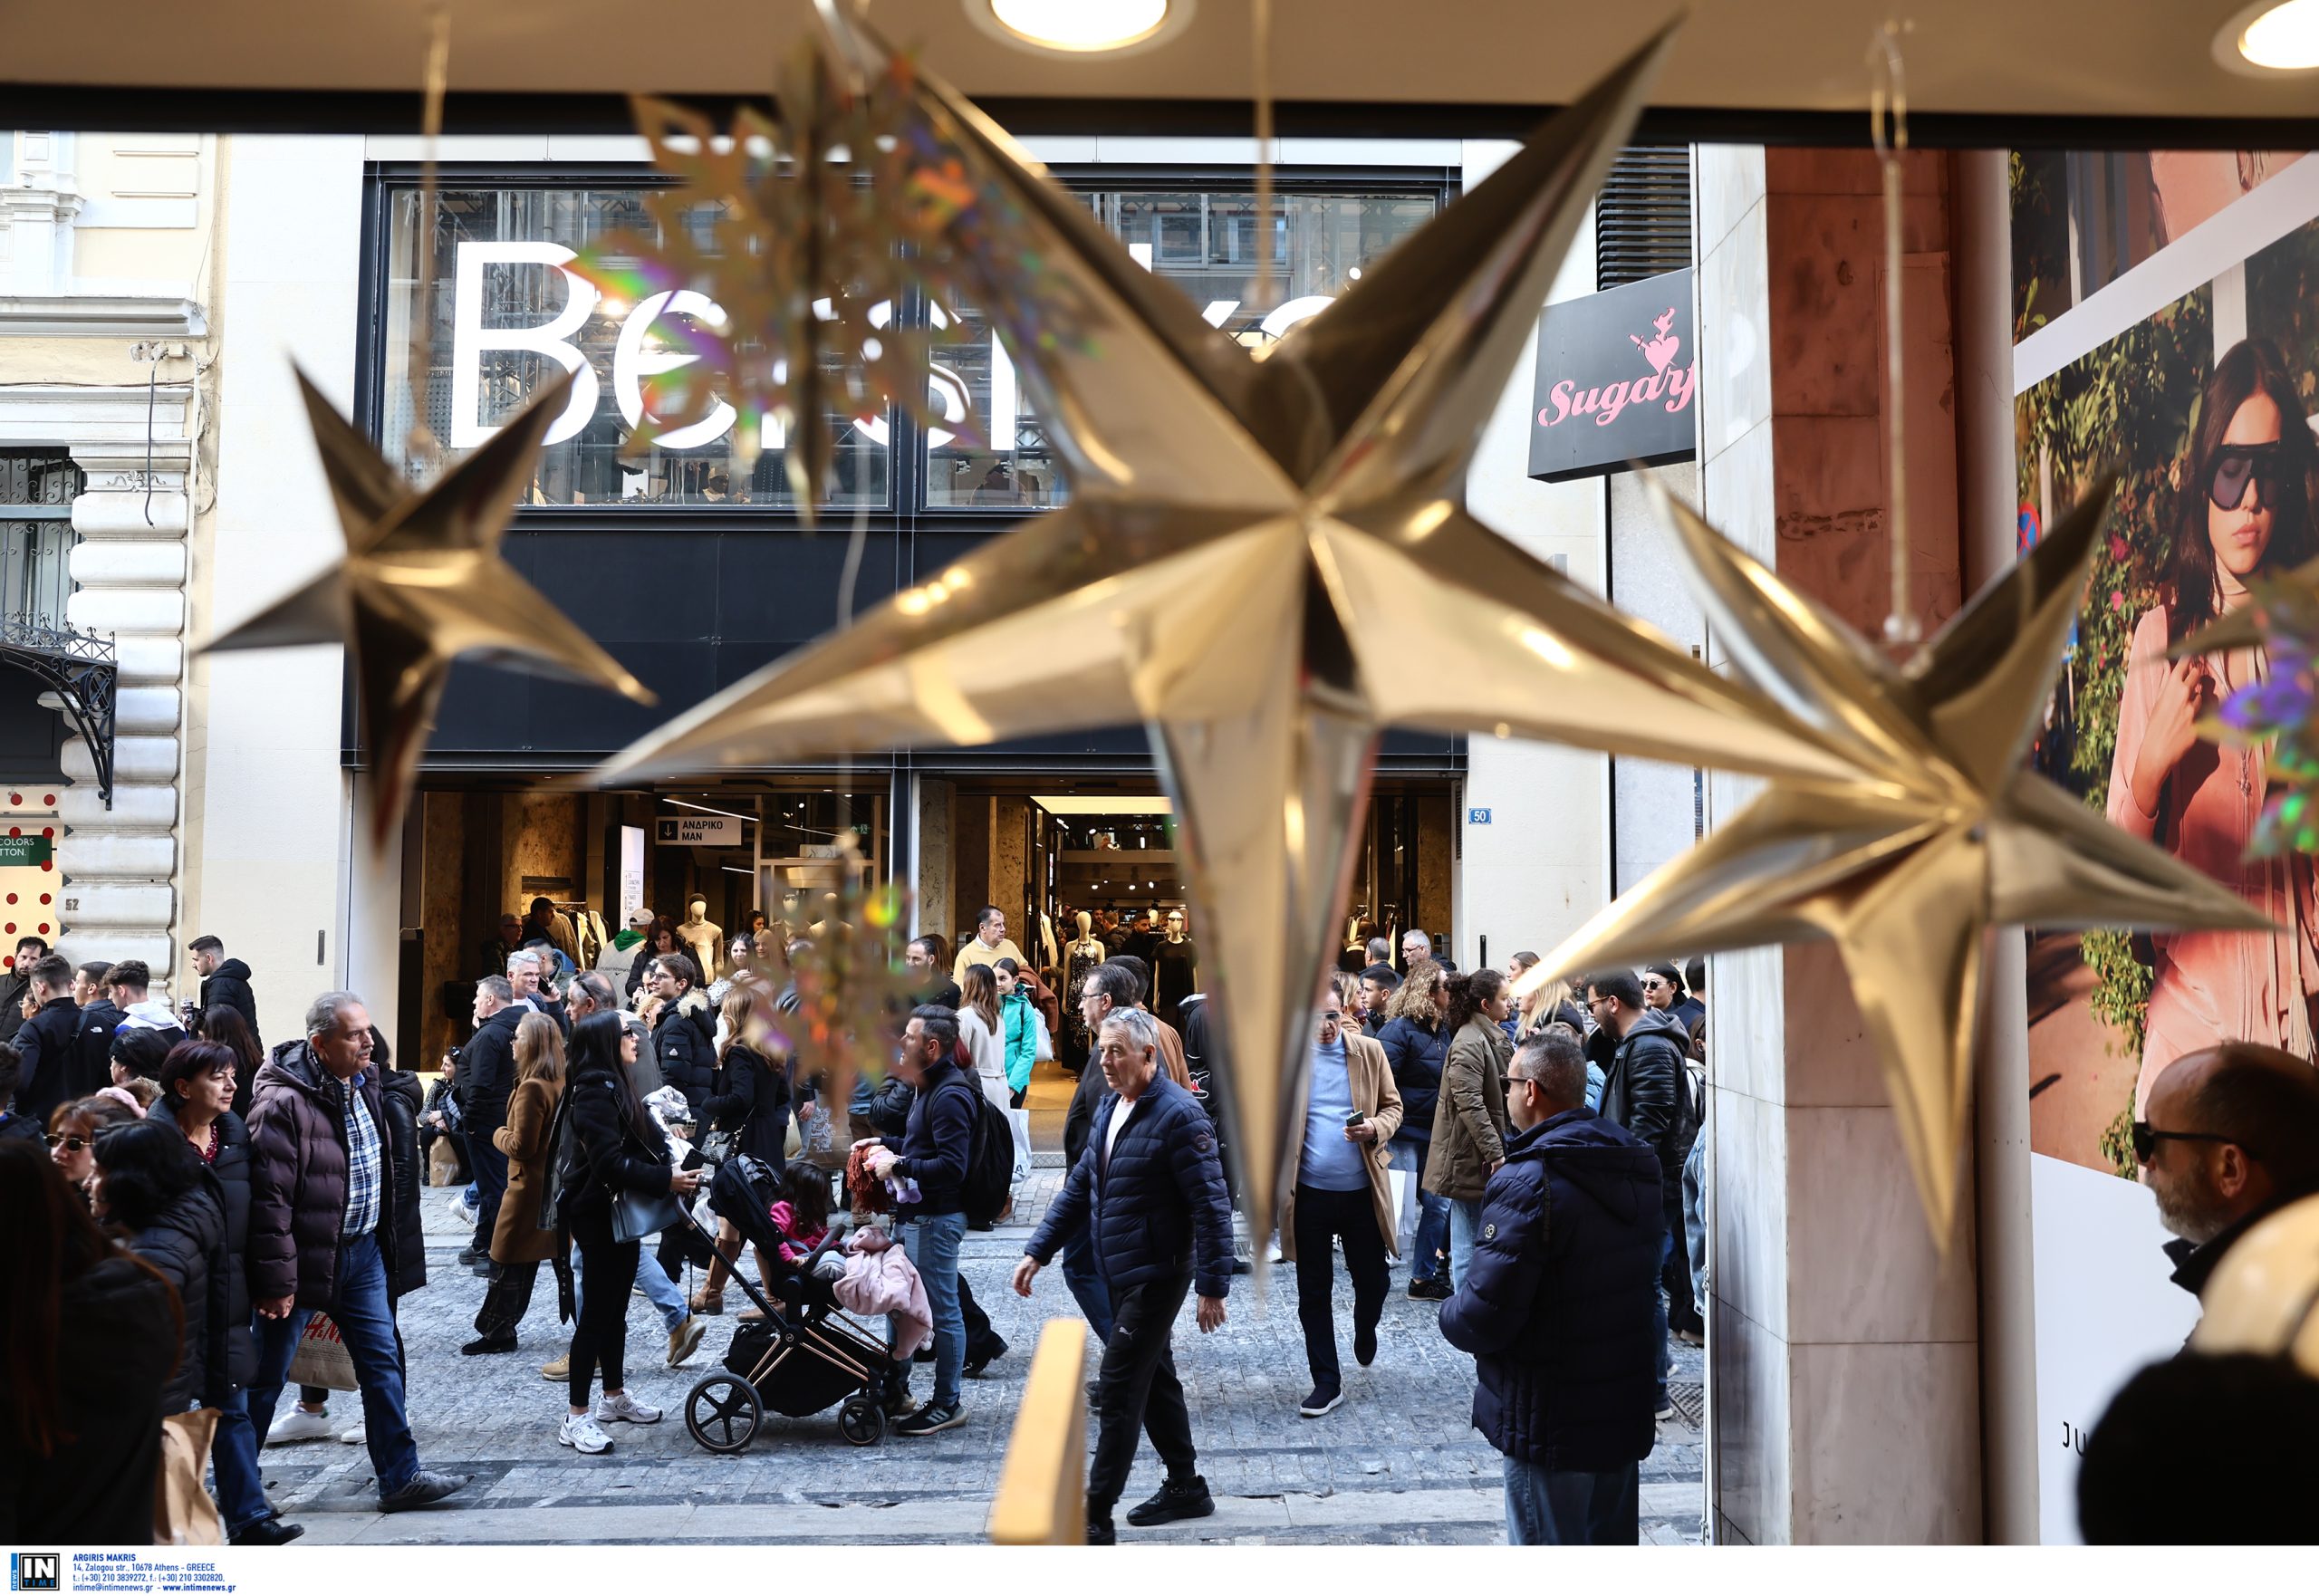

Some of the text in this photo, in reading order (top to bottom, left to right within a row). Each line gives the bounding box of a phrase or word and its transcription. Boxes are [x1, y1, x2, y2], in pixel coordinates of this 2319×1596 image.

[1537, 357, 1696, 427] Sugary
[1474, 810, 1487, 822] 50
[682, 820, 723, 830] ΑΝΔΡΙΚΟ
[681, 832, 703, 841] MAN
[65, 898, 80, 911] 52
